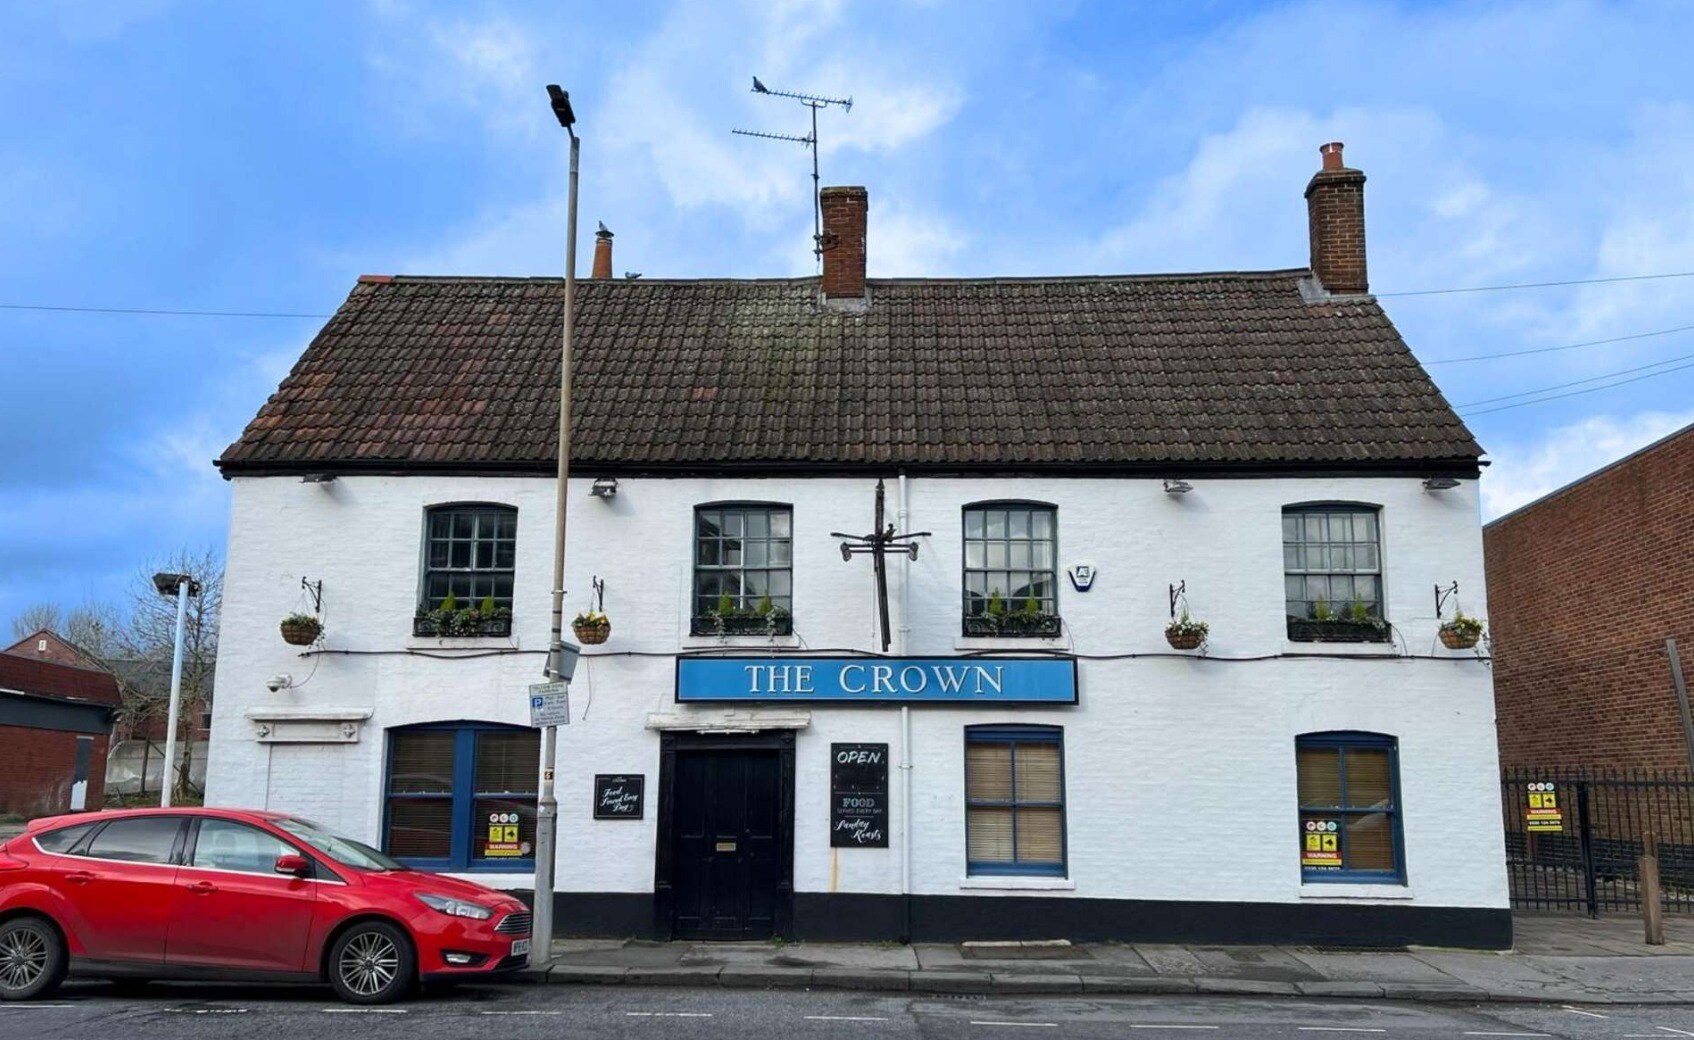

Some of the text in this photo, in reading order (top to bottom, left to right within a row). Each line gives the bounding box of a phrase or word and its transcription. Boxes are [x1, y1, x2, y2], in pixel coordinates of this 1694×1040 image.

[745, 664, 1004, 694] THE CROWN
[837, 751, 881, 764] OPEN
[842, 798, 875, 808] FOOD
[834, 819, 869, 831] Sunday
[851, 830, 881, 843] Roasts
